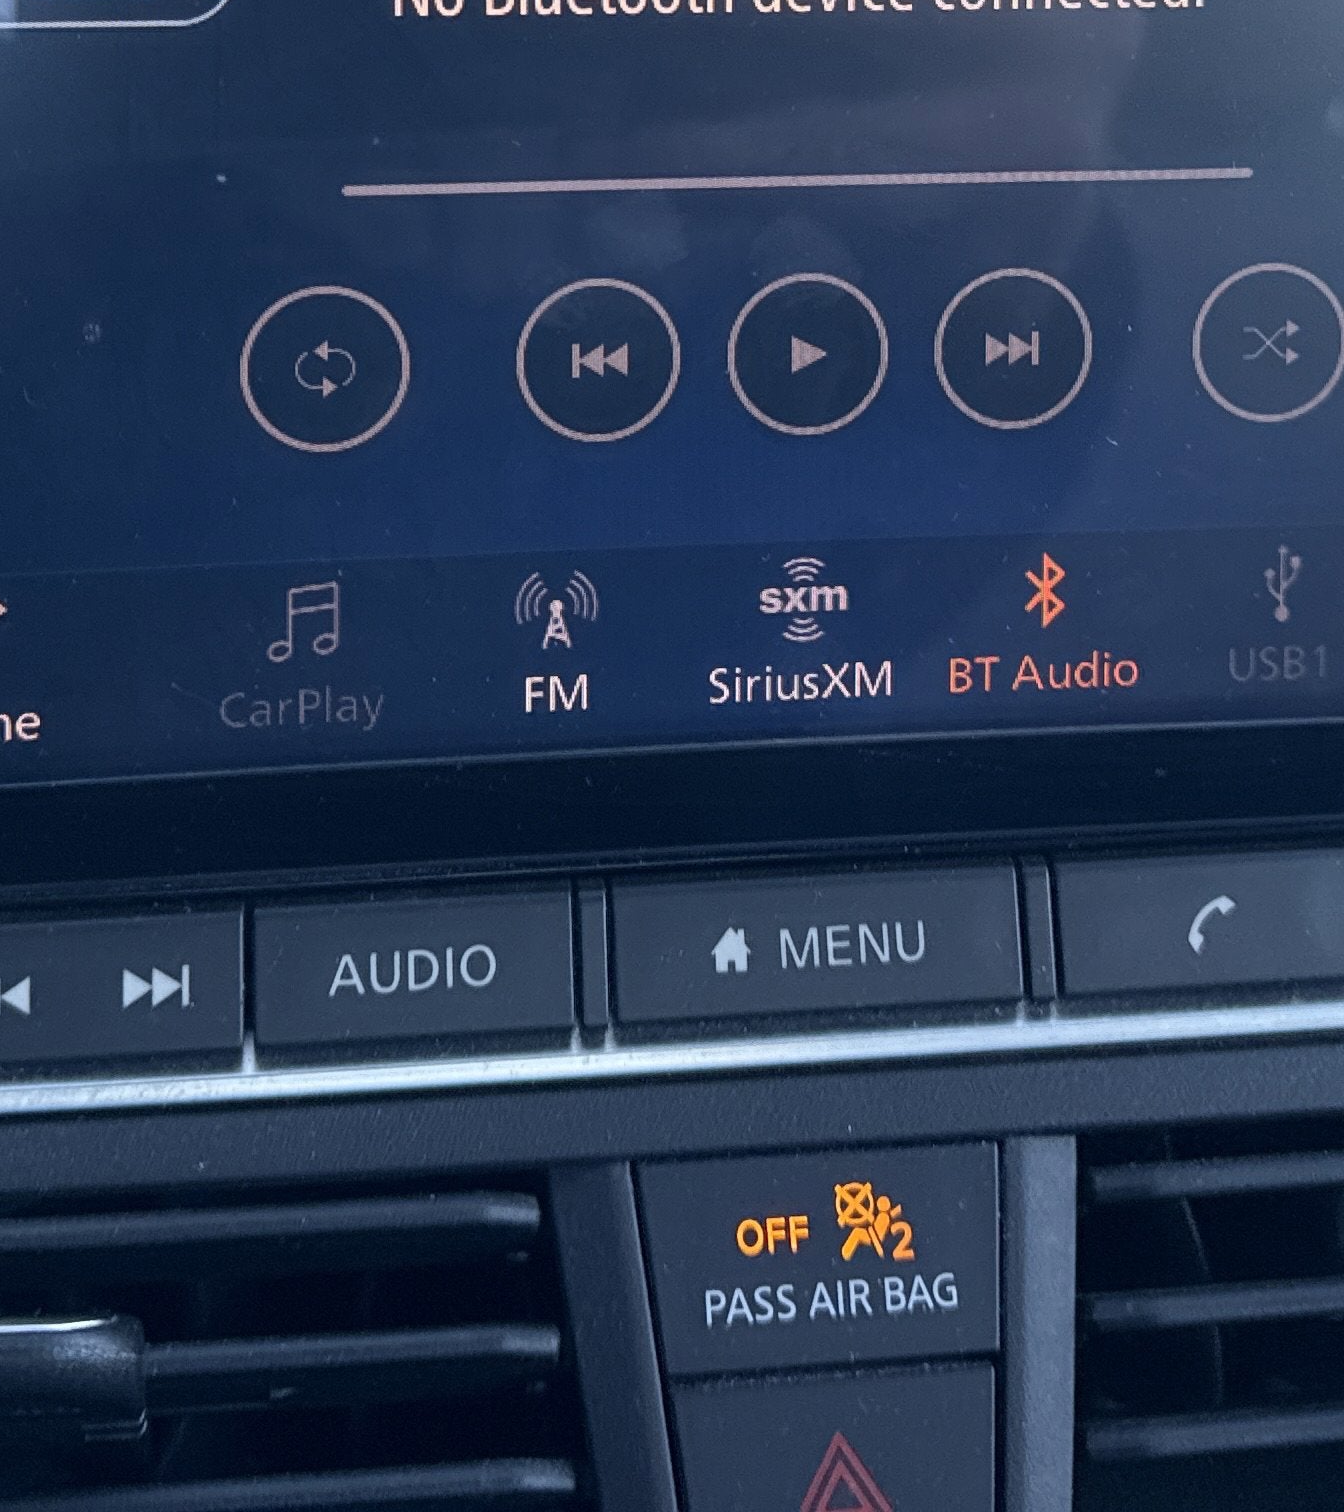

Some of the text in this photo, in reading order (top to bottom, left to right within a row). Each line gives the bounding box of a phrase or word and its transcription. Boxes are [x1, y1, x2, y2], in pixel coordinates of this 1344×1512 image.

[758, 582, 850, 616] sxm
[707, 660, 894, 706] SiriusXM
[947, 651, 1141, 694] BT Audio
[1227, 644, 1328, 682] USB1
[218, 687, 385, 736] CarPlay
[522, 673, 590, 713] FM
[778, 920, 928, 970] MENU
[328, 944, 498, 998] AUDIO
[736, 1216, 809, 1257] OFF
[704, 1272, 959, 1329] PASS AIR BAG
